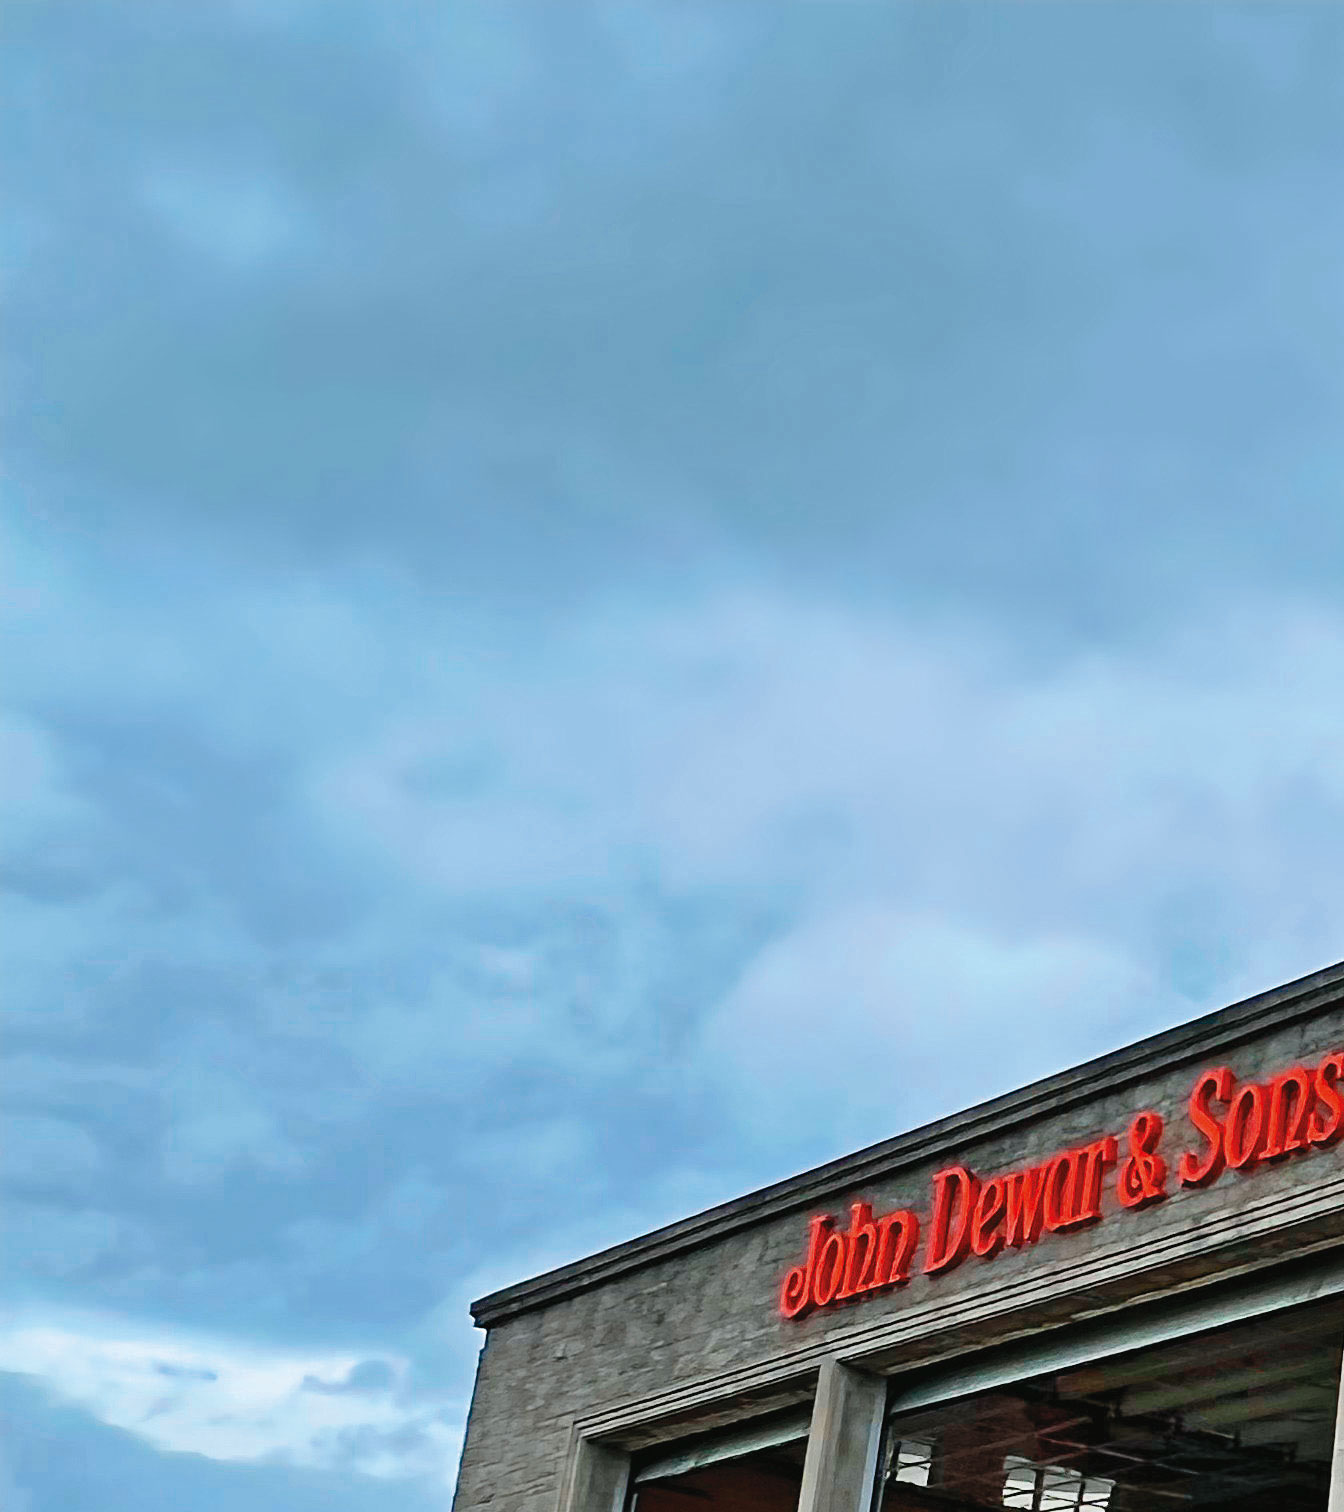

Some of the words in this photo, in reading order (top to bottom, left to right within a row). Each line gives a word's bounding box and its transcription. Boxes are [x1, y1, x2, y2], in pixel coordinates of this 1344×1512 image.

[778, 1202, 921, 1320] John
[922, 1135, 1118, 1277] Dewar
[1116, 1110, 1168, 1210] &
